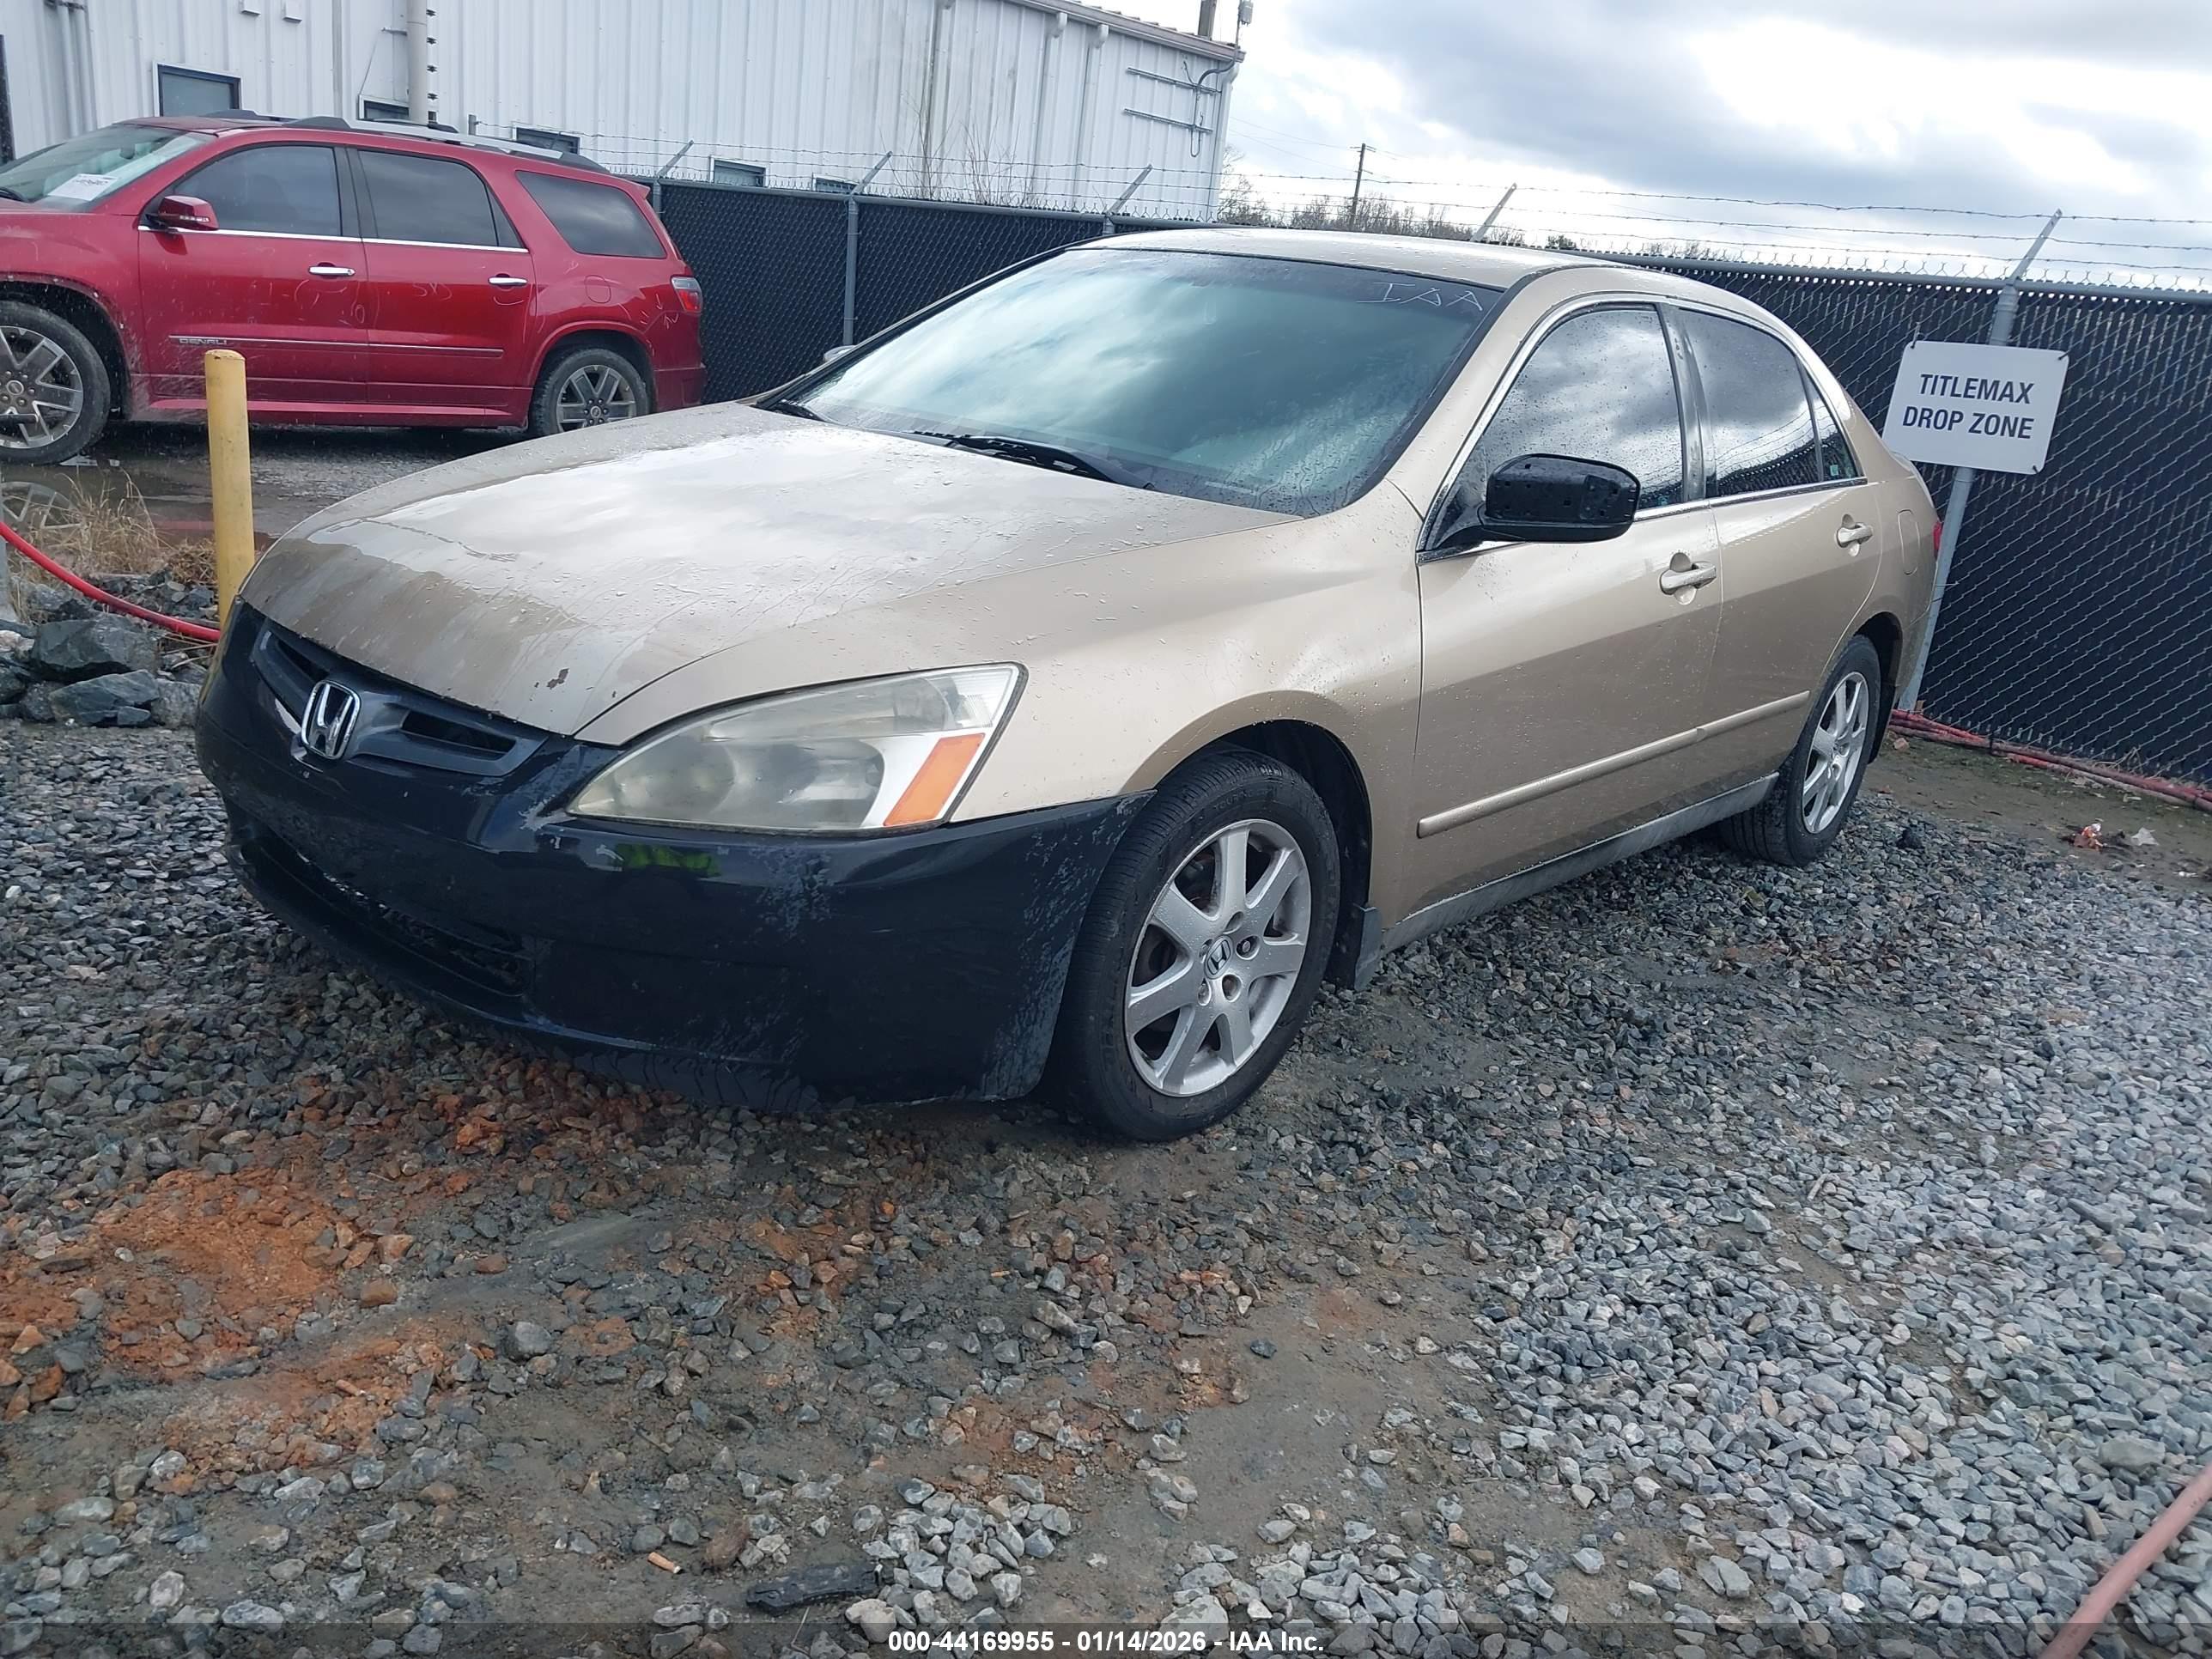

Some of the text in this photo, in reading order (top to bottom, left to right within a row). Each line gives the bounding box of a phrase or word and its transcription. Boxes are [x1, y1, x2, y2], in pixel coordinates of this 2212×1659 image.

[1356, 282, 1484, 312] IAA
[1920, 374, 2034, 404] TITLEMAX
[1902, 406, 2034, 439] DROP ZONE
